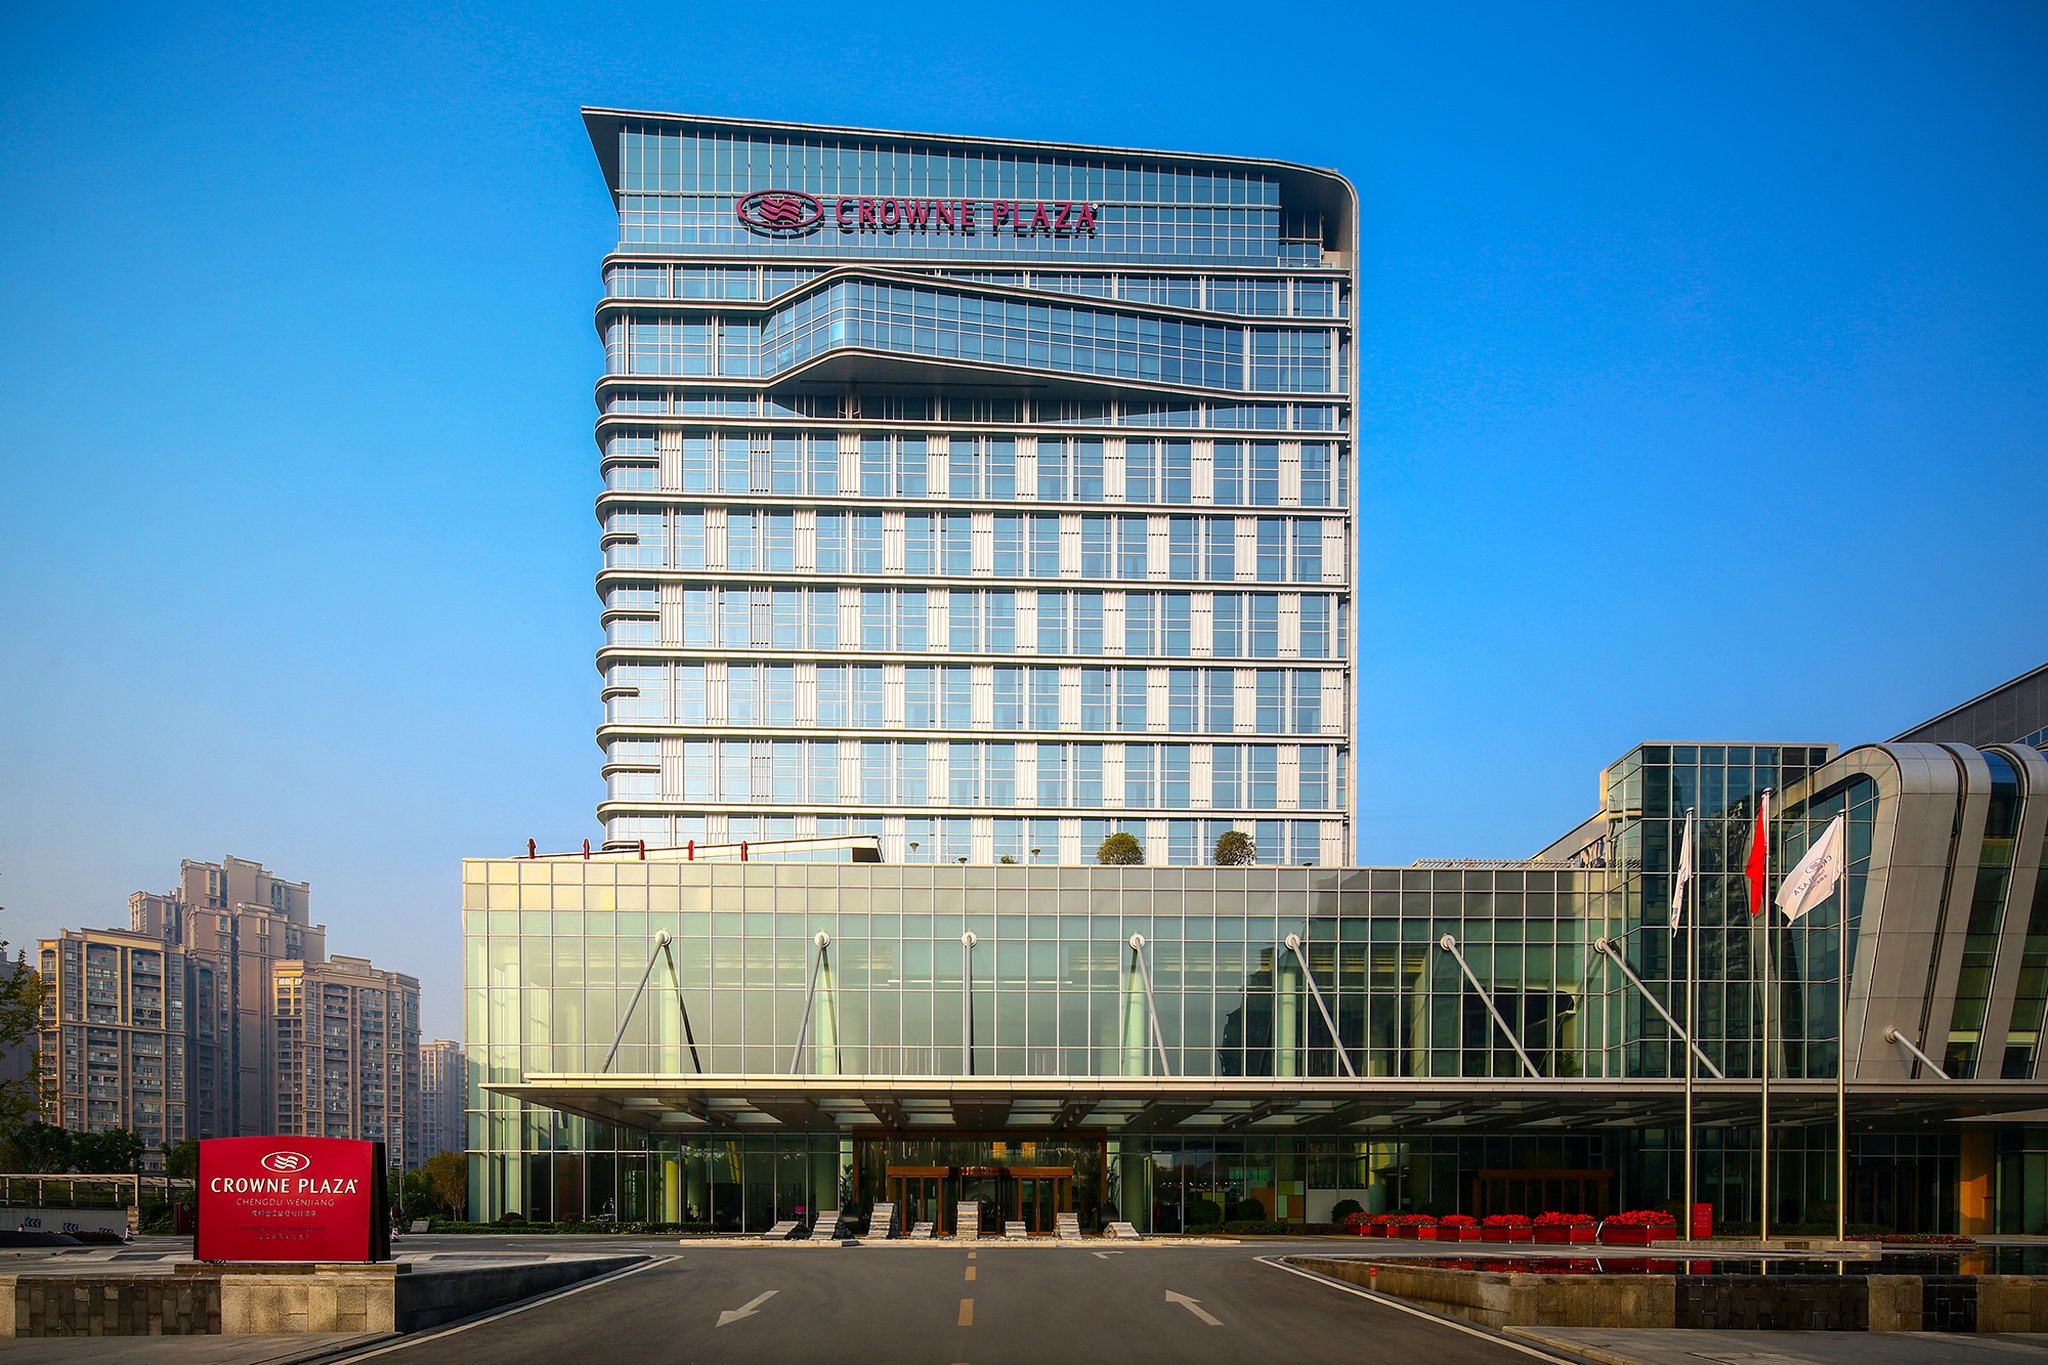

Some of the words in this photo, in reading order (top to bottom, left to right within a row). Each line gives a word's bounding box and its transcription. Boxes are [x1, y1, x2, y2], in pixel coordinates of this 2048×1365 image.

[836, 198, 976, 227] CROWNE
[993, 201, 1096, 229] PLAZA
[211, 1177, 290, 1193] CROWNE
[299, 1178, 357, 1194] PLAZA
[236, 1198, 283, 1206] CHENGDU
[286, 1198, 335, 1207] WENJIANG
